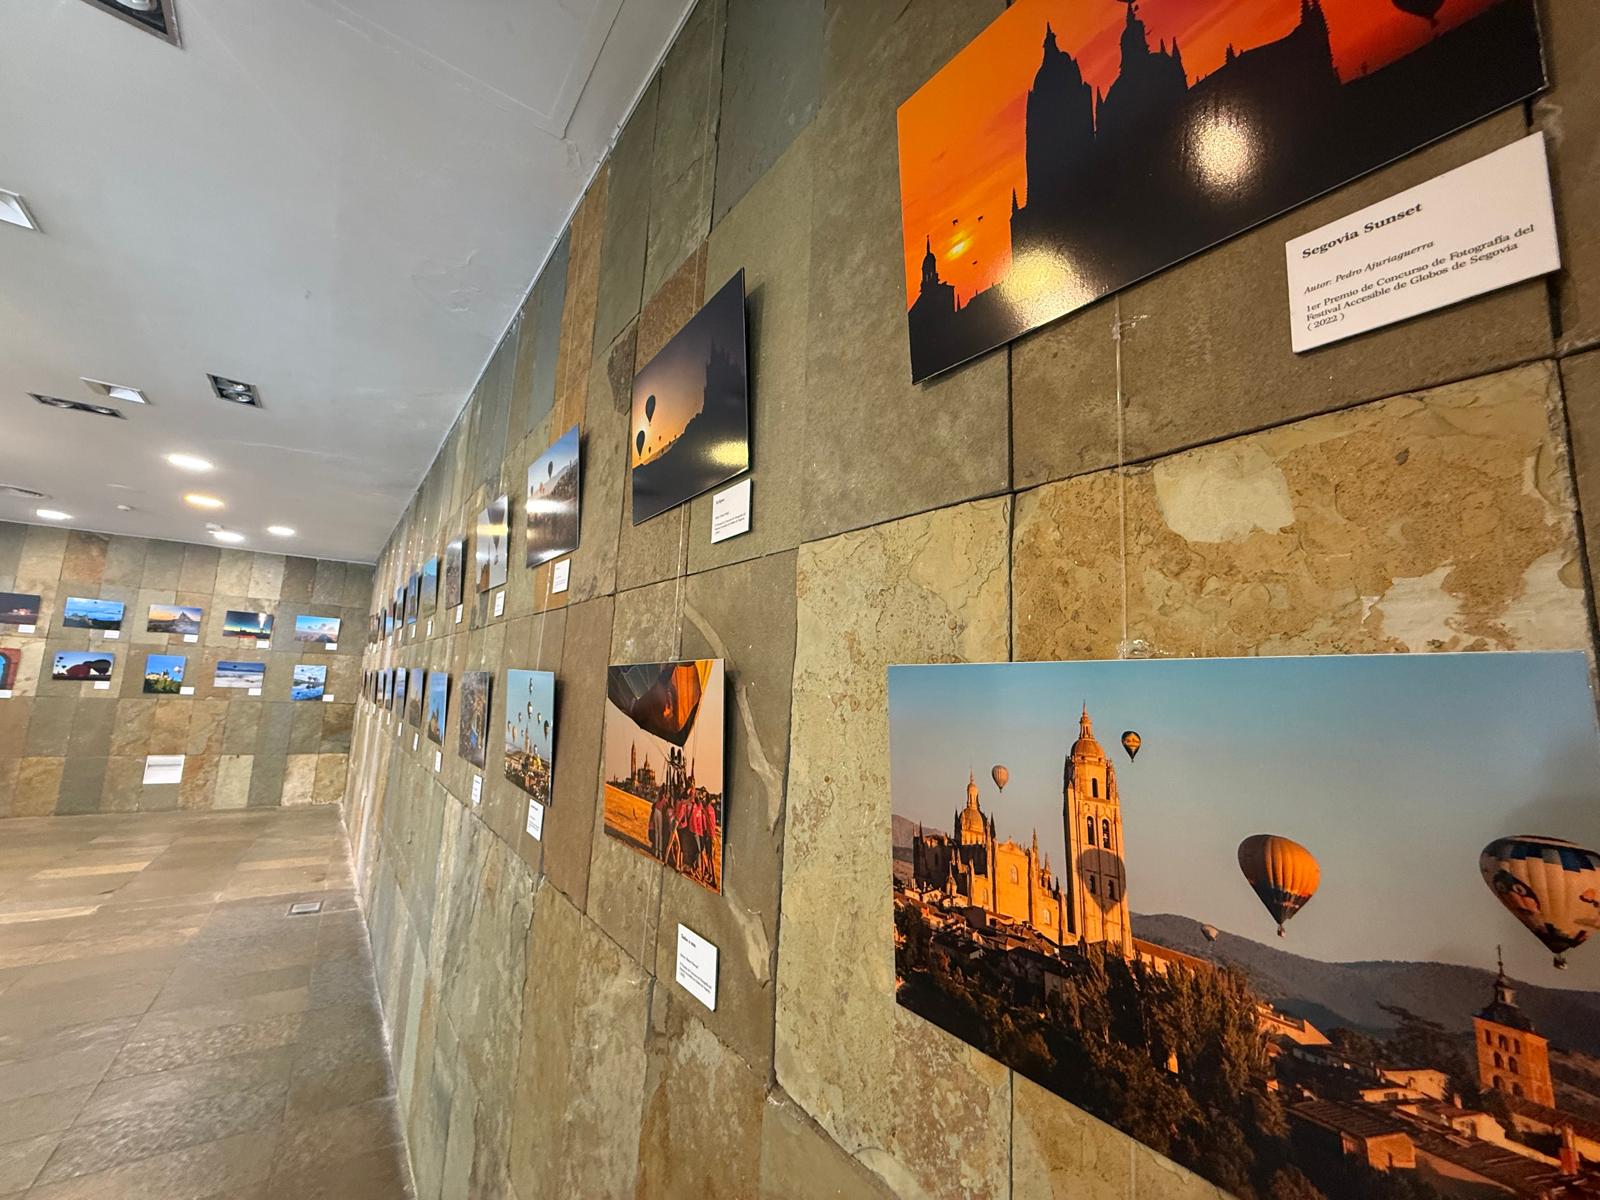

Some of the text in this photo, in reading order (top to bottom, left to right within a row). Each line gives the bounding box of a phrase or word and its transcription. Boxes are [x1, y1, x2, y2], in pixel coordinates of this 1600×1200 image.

[1302, 203, 1423, 259] Segovia Sunset
[1336, 268, 1363, 283] Pedro
[1364, 240, 1435, 271] Ajuriaguerra
[1306, 302, 1321, 312] 1er
[1323, 287, 1359, 306] Premio
[1361, 281, 1374, 290] de
[1377, 263, 1429, 285] Concurso
[1432, 257, 1445, 267] de
[1514, 224, 1534, 239] del
[1306, 243, 1518, 322] Festival Accesible de Globos de Segovia
